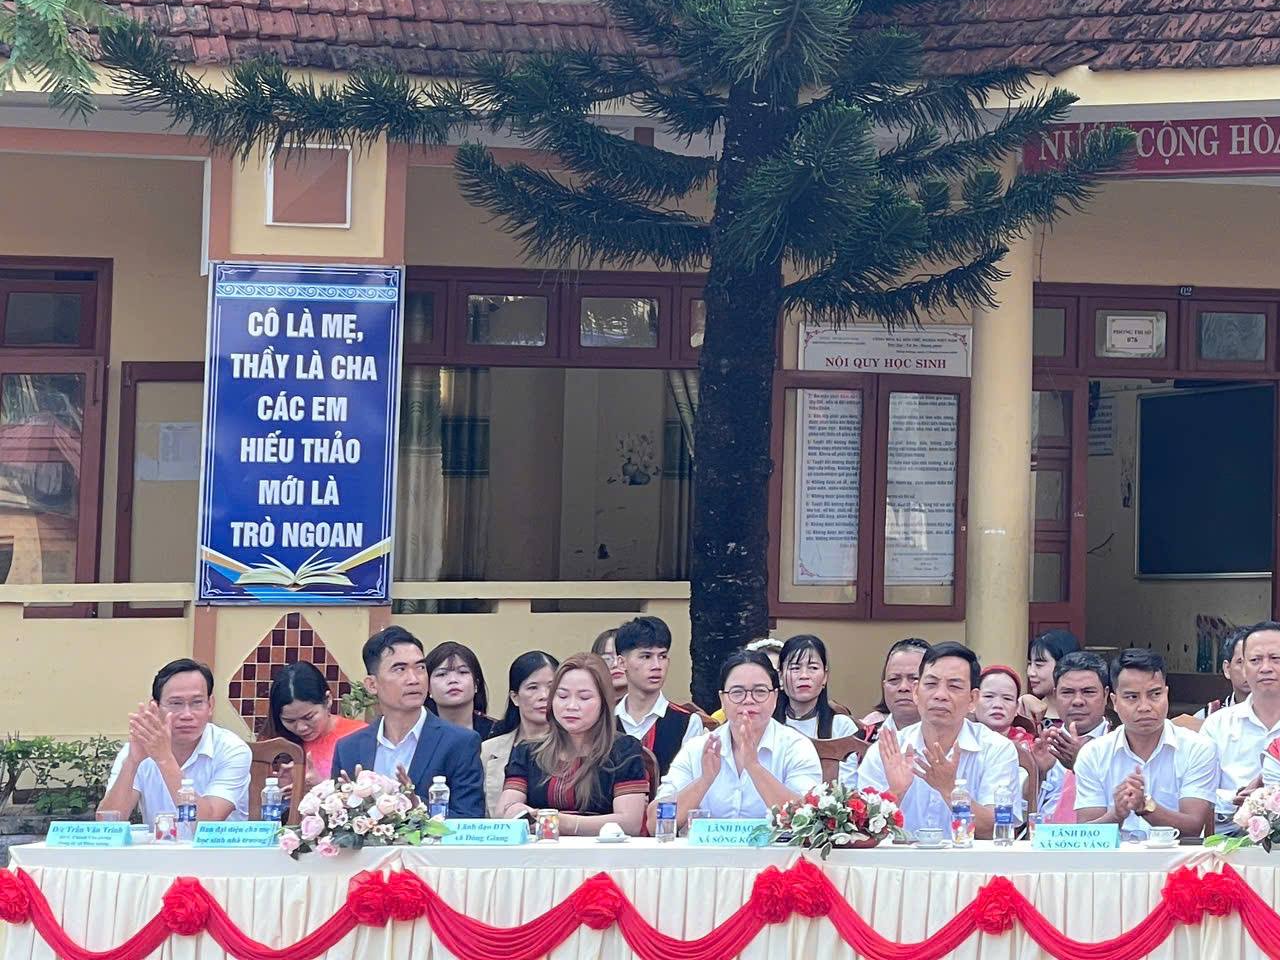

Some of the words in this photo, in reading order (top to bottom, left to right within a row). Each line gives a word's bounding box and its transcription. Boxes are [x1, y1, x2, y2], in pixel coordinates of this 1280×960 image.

[1137, 120, 1219, 165] CỘNG
[1180, 287, 1192, 296] 02
[248, 307, 279, 337] CÔ
[287, 308, 314, 338] LÀ
[321, 314, 364, 344] MẸ,
[230, 345, 289, 380] THẦY
[296, 350, 324, 380] LÀ
[331, 356, 377, 381] CHA
[825, 354, 849, 370] NỘI
[853, 357, 880, 371] QUY
[884, 358, 912, 371] HỌC
[915, 359, 946, 370] SINH
[257, 391, 305, 421] CÁC
[312, 397, 347, 421] EM
[240, 431, 294, 464] HIẾU
[302, 432, 360, 464] THẢO
[258, 475, 304, 506] MỚI
[311, 476, 339, 506] LÀ
[230, 516, 275, 548] TRÒ
[282, 523, 363, 548] NGOAN
